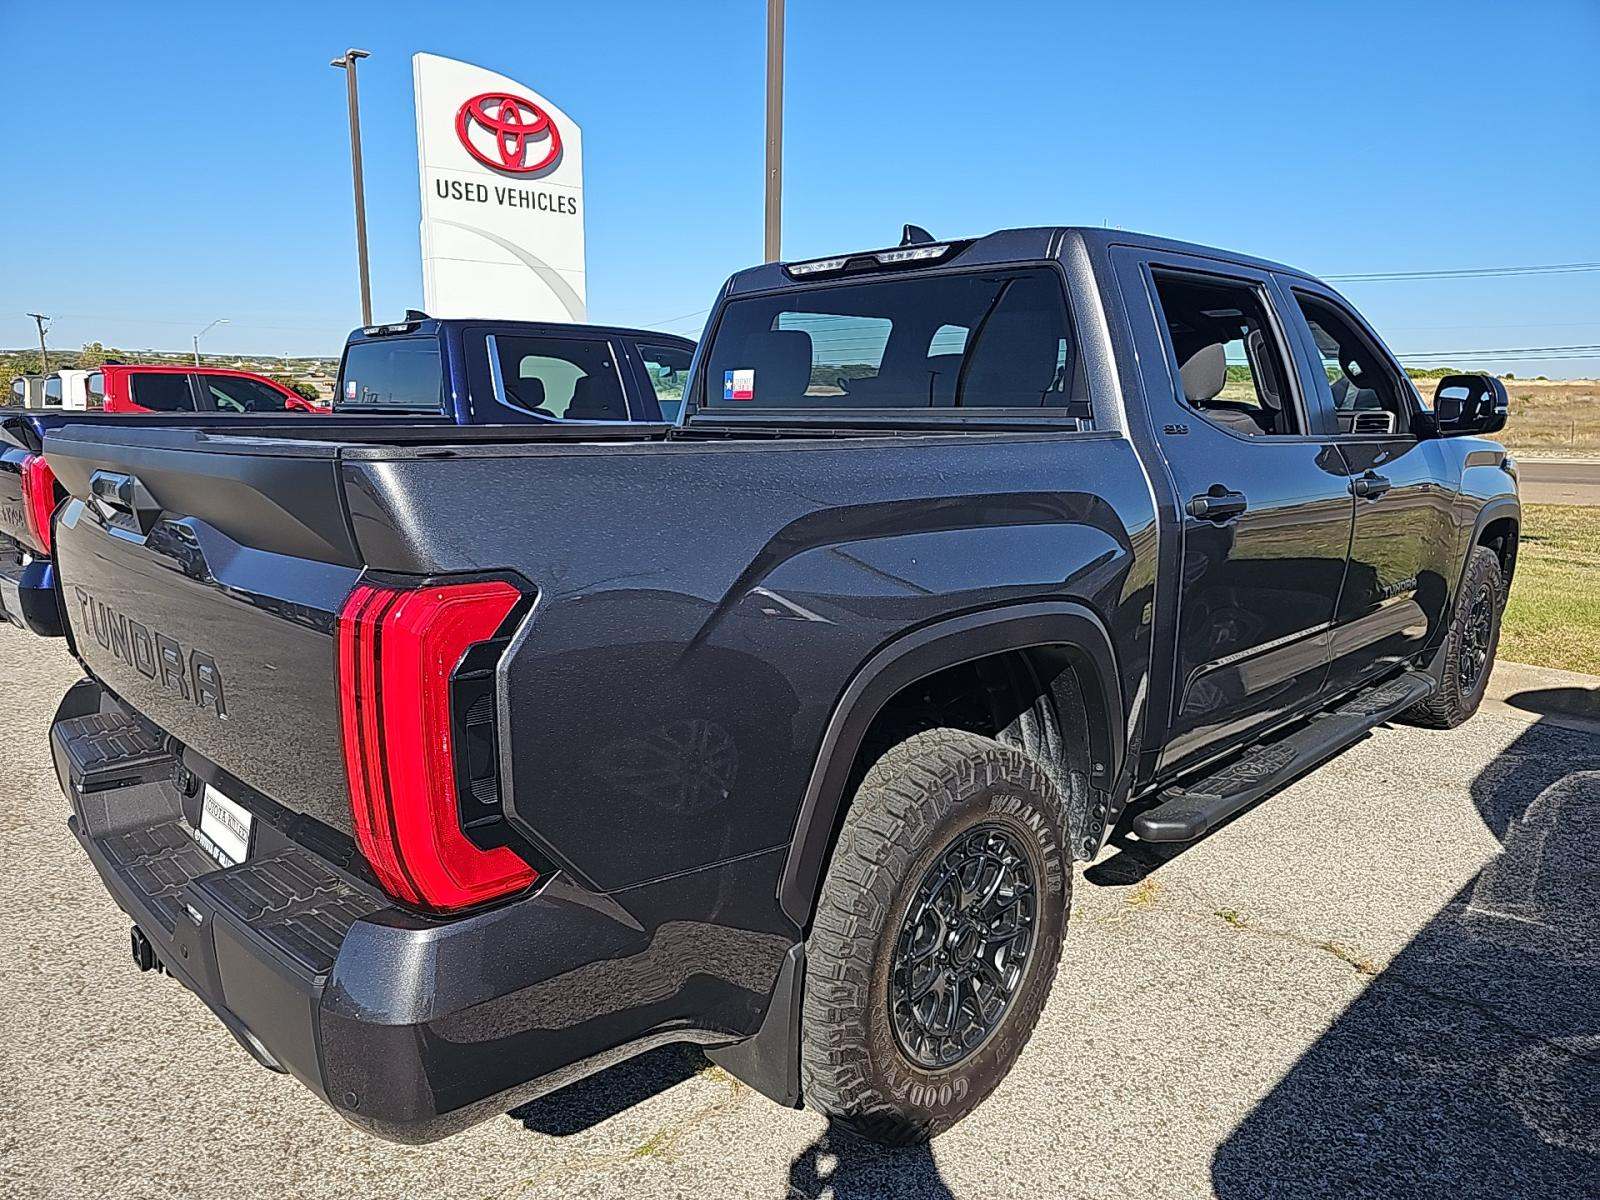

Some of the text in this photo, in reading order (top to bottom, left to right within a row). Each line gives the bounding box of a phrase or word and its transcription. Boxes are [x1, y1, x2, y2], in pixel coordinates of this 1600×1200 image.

[436, 178, 577, 215] USED VEHICLES
[1382, 577, 1417, 598] TUNDRA
[75, 585, 230, 720] TUNDRA
[984, 793, 1061, 895] WRANGLER
